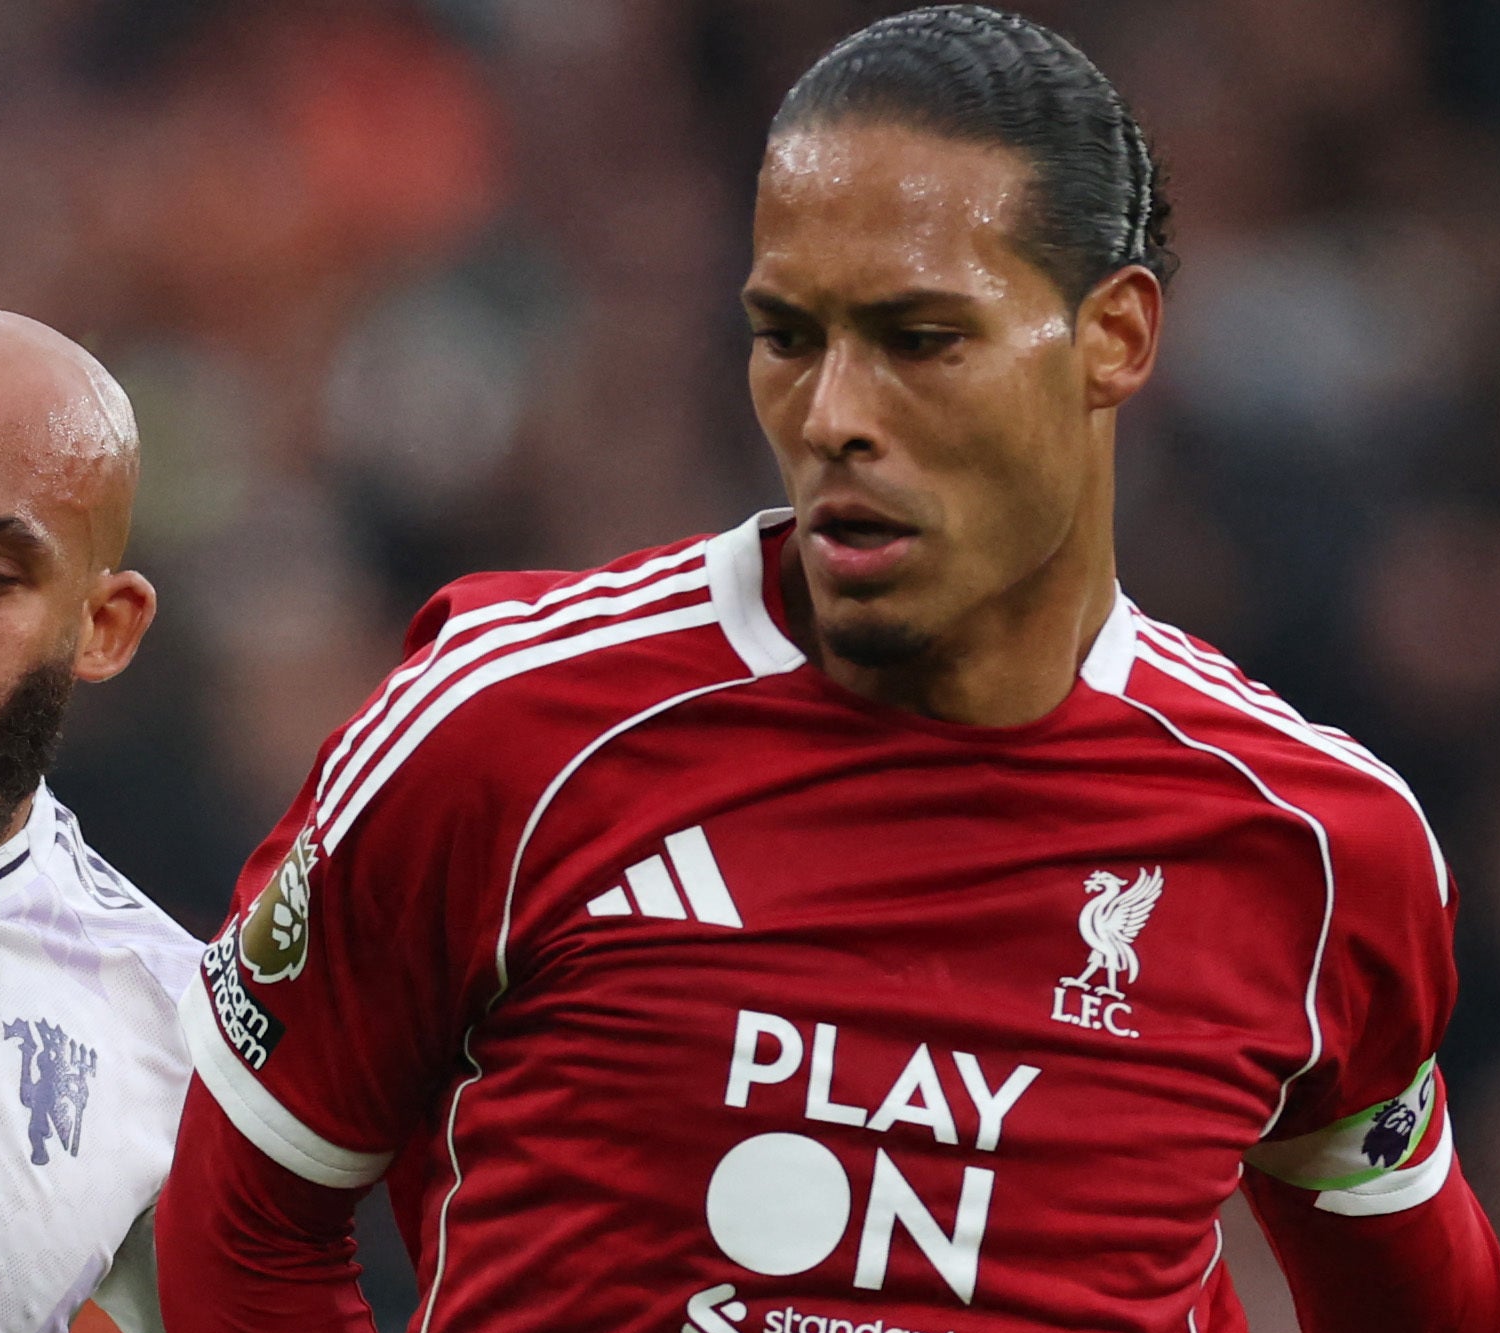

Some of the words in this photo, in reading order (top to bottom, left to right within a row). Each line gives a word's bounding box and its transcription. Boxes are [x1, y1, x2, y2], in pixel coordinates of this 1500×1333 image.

[212, 974, 267, 1070] racism
[225, 956, 269, 1039] room
[1051, 987, 1140, 1039] L.F.C.
[724, 1009, 1042, 1152] PLAY
[706, 1132, 995, 1305] ON
